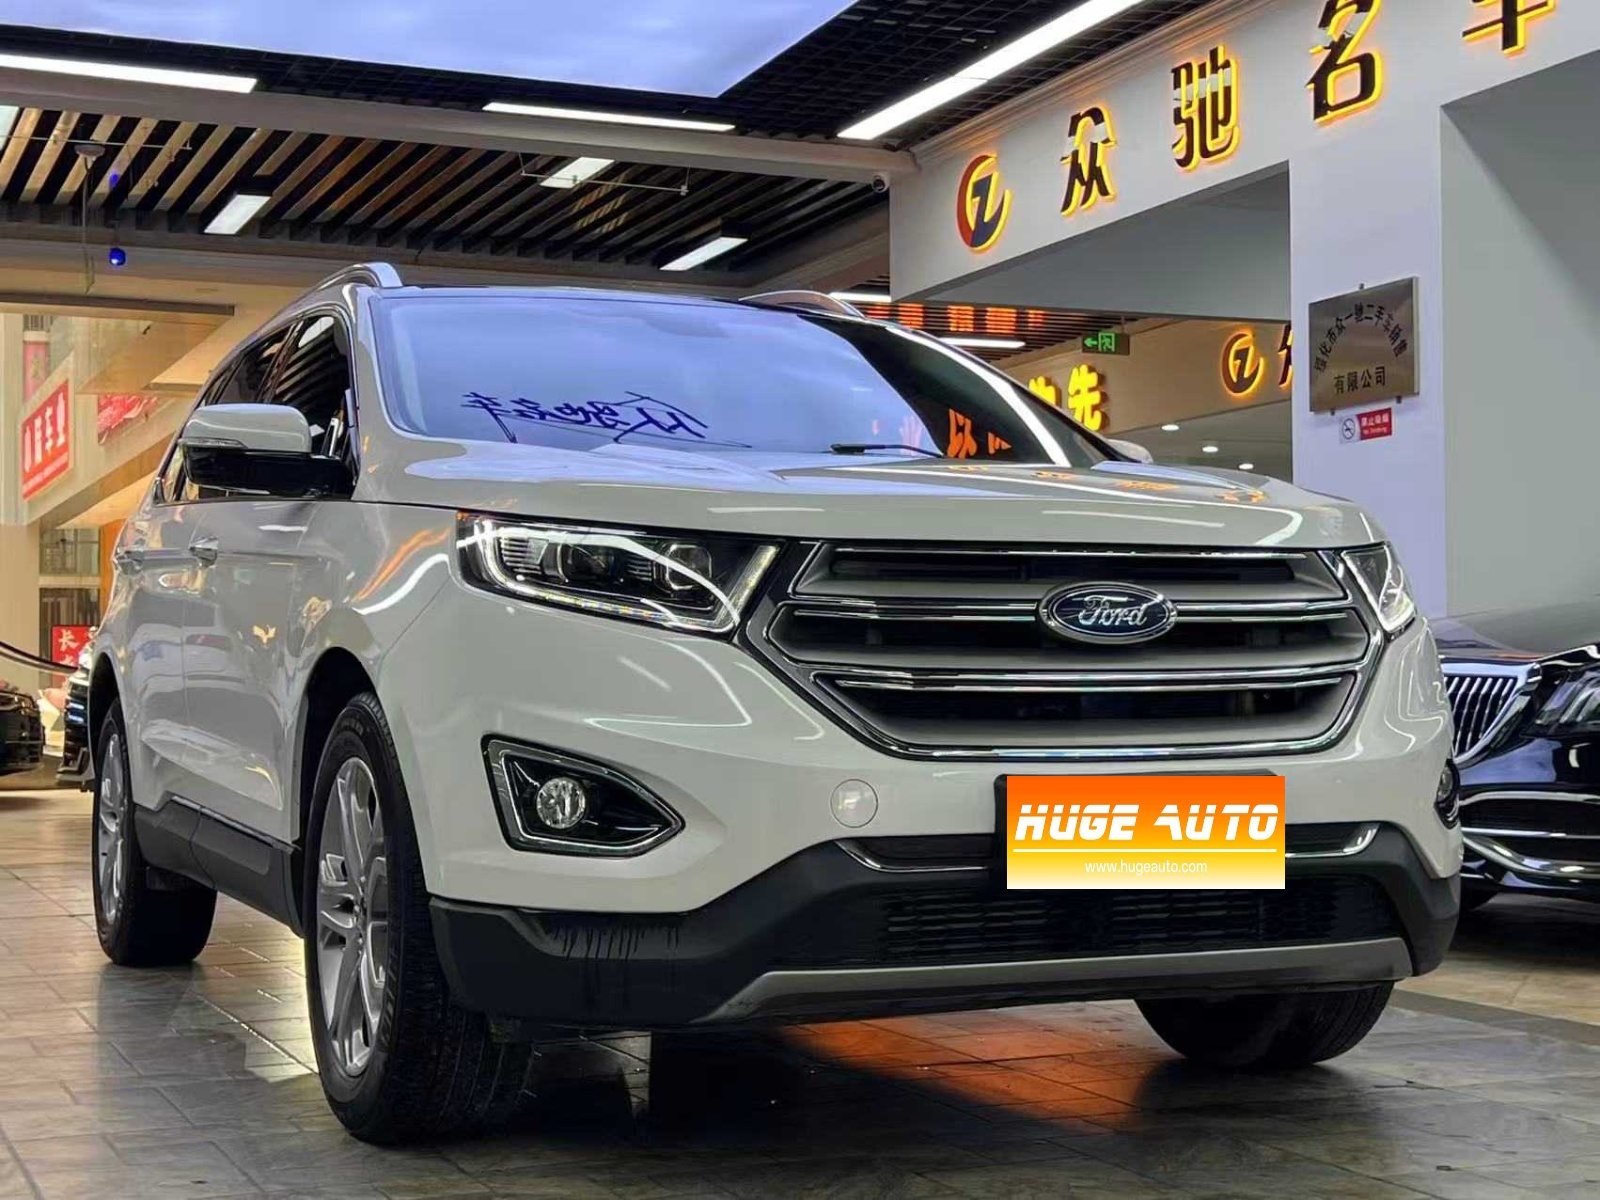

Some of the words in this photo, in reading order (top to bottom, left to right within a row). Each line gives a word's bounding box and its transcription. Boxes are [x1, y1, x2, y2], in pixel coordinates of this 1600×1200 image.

[1334, 366, 1386, 395] 有限公司
[1068, 594, 1152, 627] Ford
